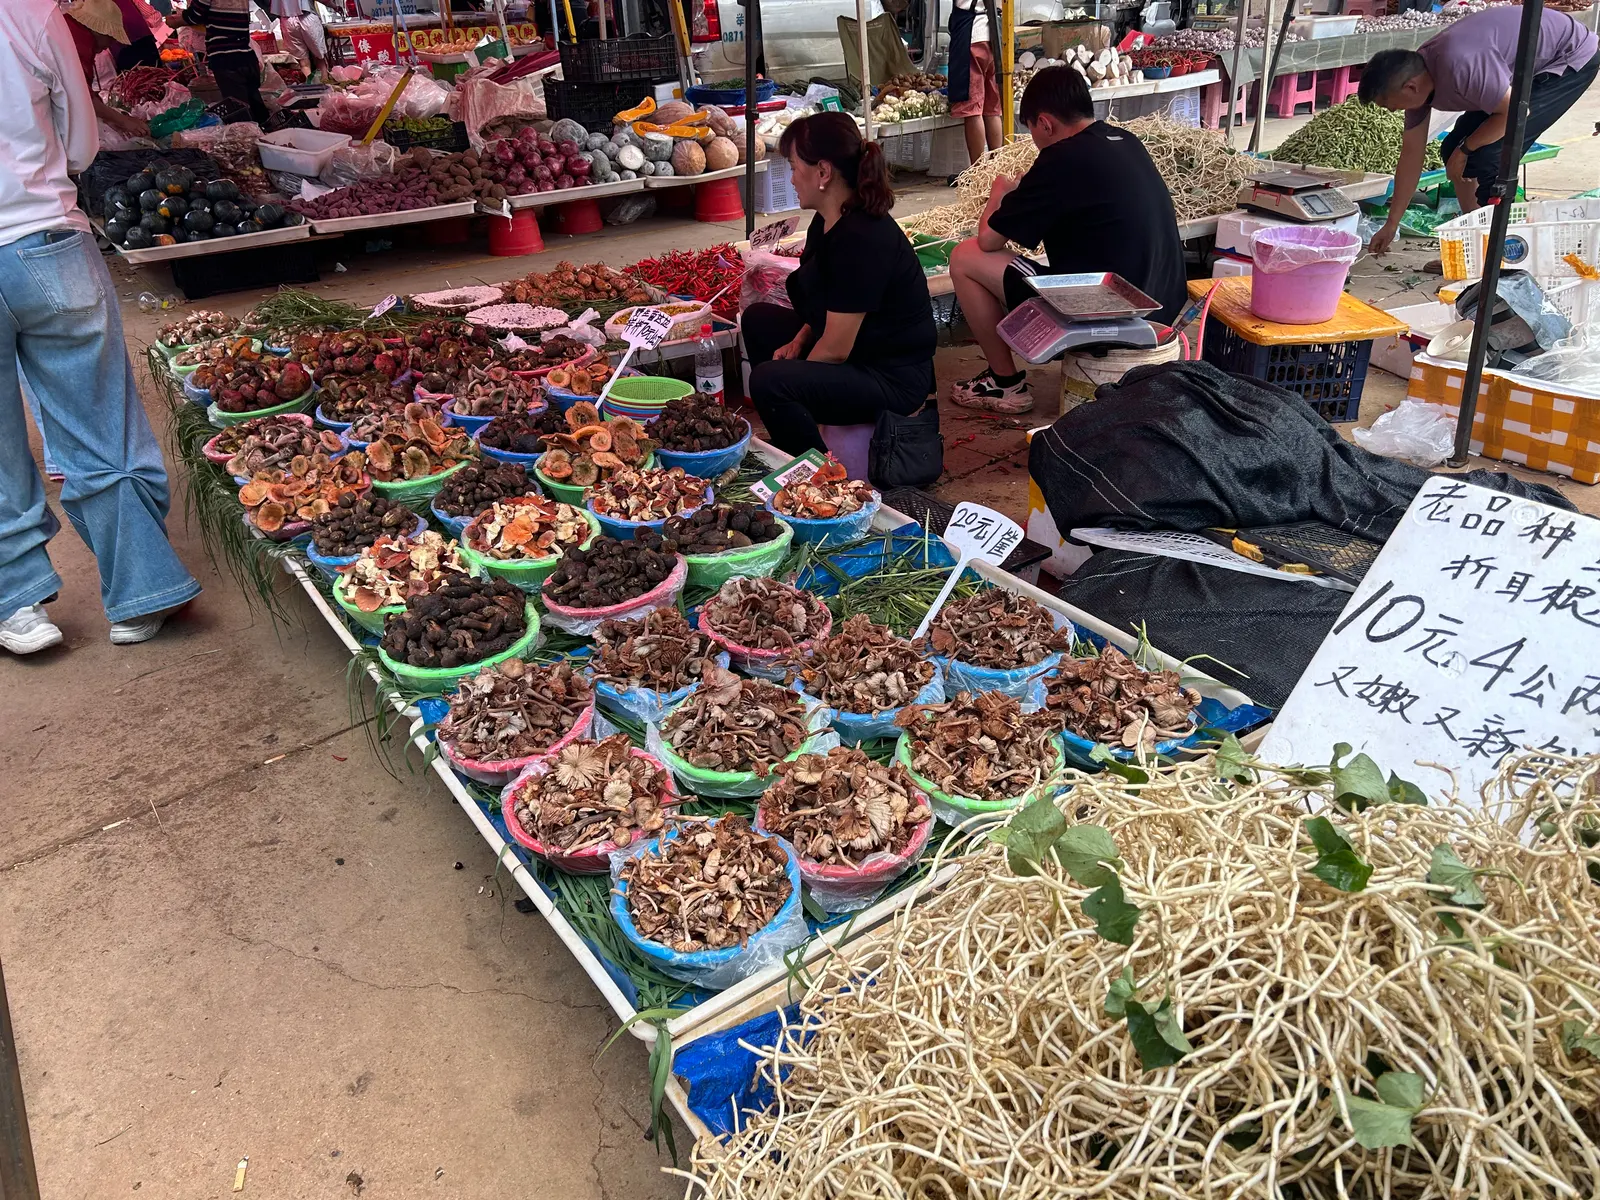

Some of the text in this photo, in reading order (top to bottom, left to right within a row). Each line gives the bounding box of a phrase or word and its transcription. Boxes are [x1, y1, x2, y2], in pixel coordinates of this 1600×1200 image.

[1419, 483, 1600, 582] 老品种
[1440, 554, 1600, 628] 折耳根
